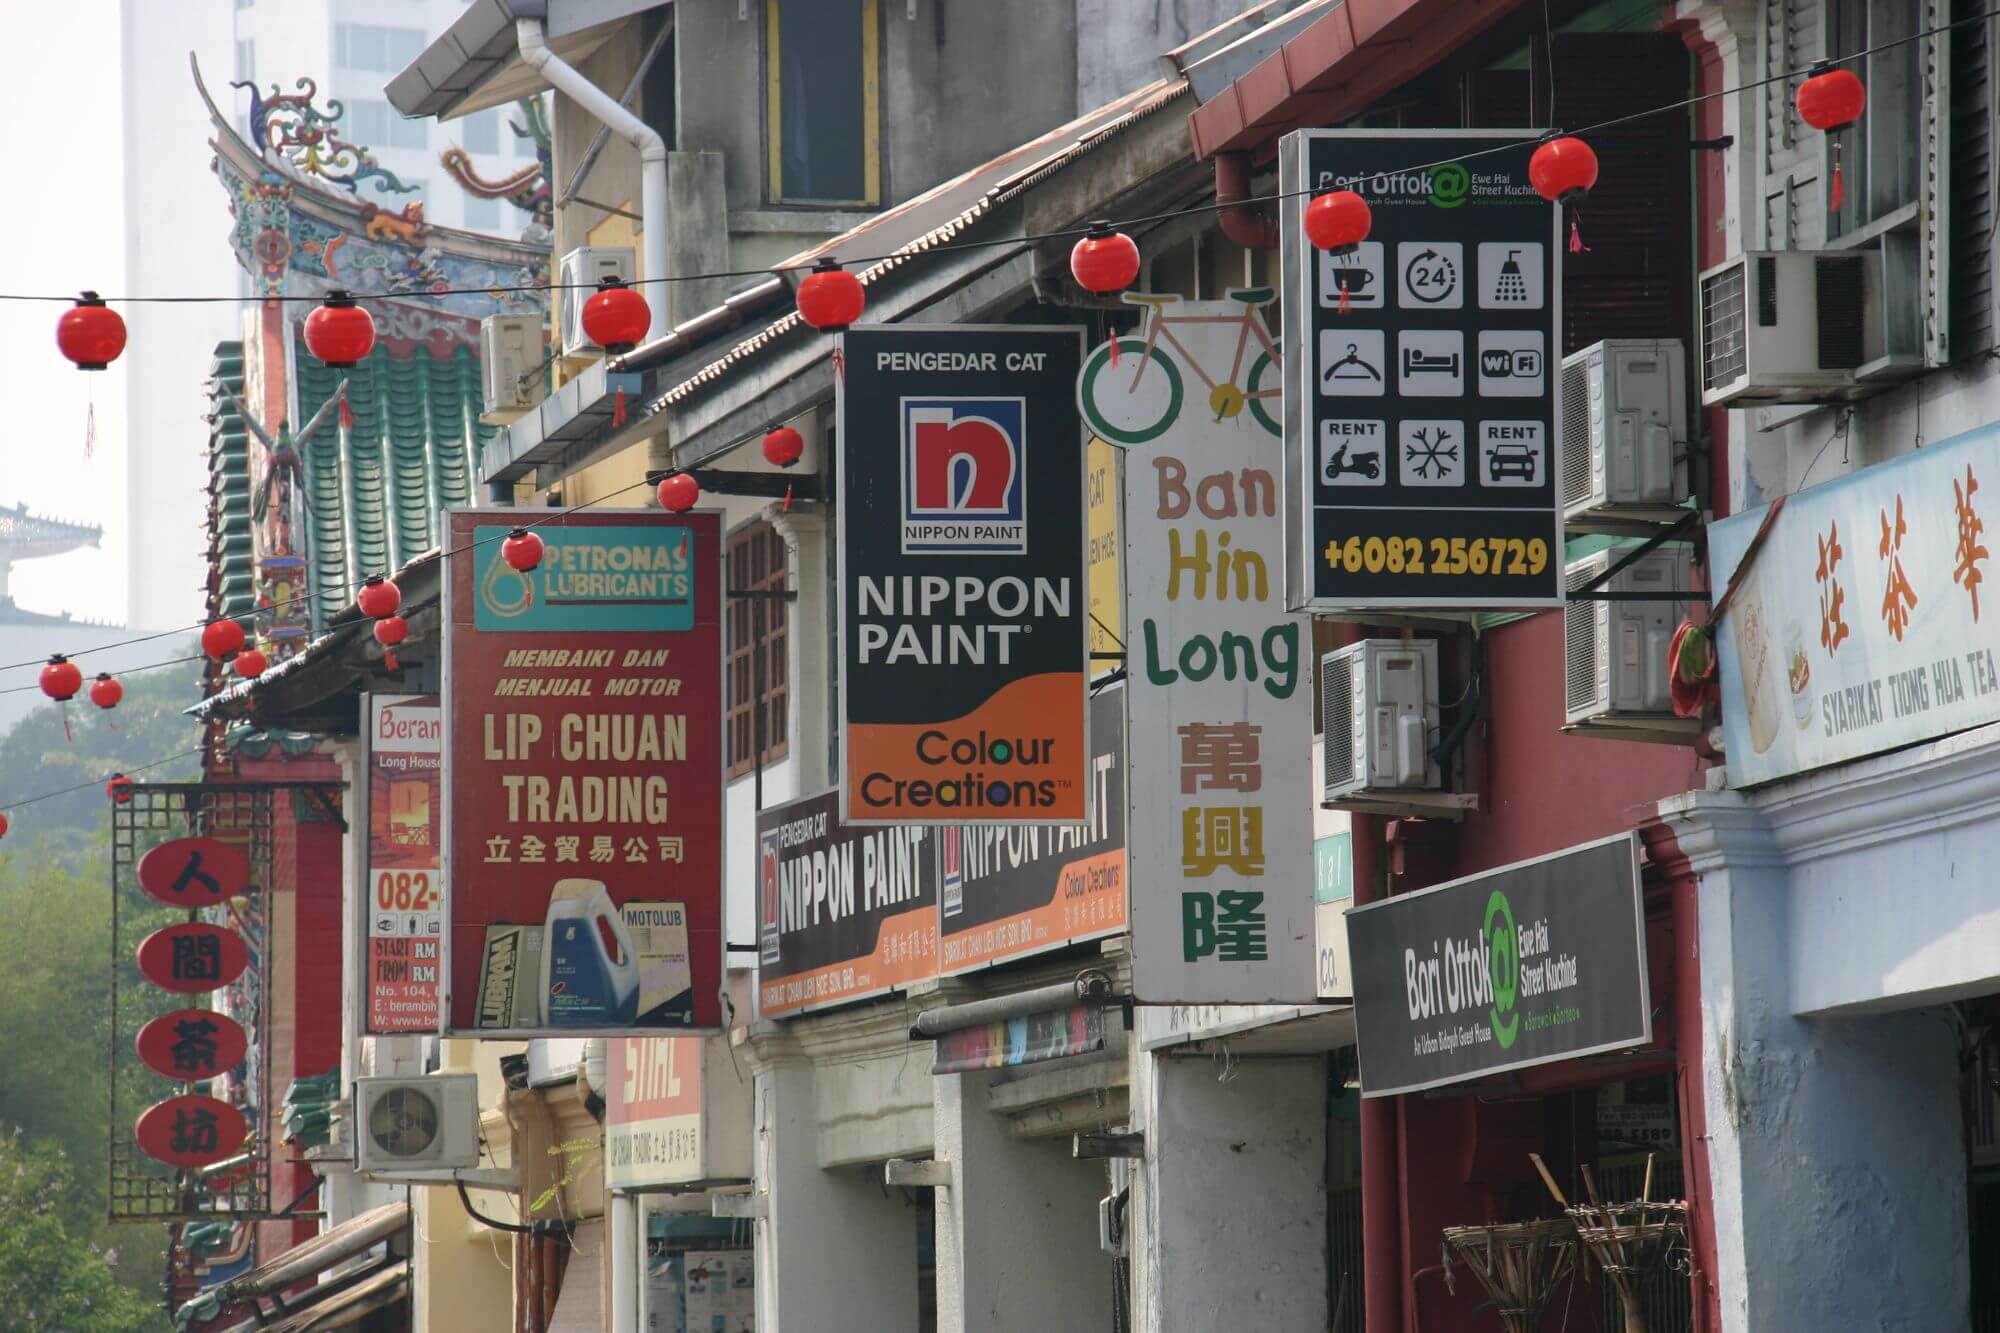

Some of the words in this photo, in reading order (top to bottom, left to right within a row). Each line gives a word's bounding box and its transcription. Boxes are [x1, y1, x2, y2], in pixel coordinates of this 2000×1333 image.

[1372, 170, 1433, 195] Ottok
[1472, 173, 1492, 184] Ewe
[1494, 173, 1510, 184] Hai
[1472, 184, 1502, 196] Street
[1504, 184, 1541, 196] Kuchin
[1415, 267, 1447, 287] 24
[876, 352, 997, 371] PENGEDAR
[1005, 352, 1047, 371] CAT
[1329, 423, 1378, 435] RENT
[1487, 426, 1537, 439] RENT
[1088, 467, 1106, 509] CAT
[1152, 456, 1276, 520] Ban
[905, 526, 969, 540] NIPPON
[974, 526, 1023, 540] PAINT
[544, 545, 688, 572] PETRONAS
[1167, 528, 1269, 602] Hin
[1324, 535, 1425, 574] +6082
[1430, 537, 1548, 576] 256729
[544, 573, 689, 597] LUBRICANTS
[858, 575, 1071, 617] NIPPON
[504, 649, 615, 667] MEMBAIKI
[622, 649, 670, 667] DAN
[1143, 618, 1299, 700] Long
[494, 678, 592, 697] MENJUAL
[604, 678, 682, 697] MOTOR
[1822, 679, 1882, 738] SYARIKAT
[1888, 666, 1930, 719] TIONG
[1931, 657, 1964, 707] HUA
[1967, 647, 1999, 698] TEA
[484, 713, 543, 761] LIP
[560, 713, 687, 762] CHUAN
[916, 730, 1055, 766] Colour
[379, 756, 407, 770] Long
[502, 775, 669, 824] TRADING
[780, 816, 814, 848] PENGEDAR
[814, 812, 828, 839] CAT
[484, 835, 686, 864] 立全貿易公司
[780, 839, 855, 935] NIPPON
[863, 826, 924, 912] PAINT
[627, 909, 682, 927] MOTOLUB
[375, 937, 410, 957] START
[414, 942, 436, 959] RM
[1518, 924, 1534, 958] Ewe
[1535, 918, 1549, 954] Hai
[376, 961, 408, 983] FROM
[412, 966, 435, 982] RM
[1405, 940, 1443, 1021] Bori
[1445, 928, 1494, 1014] Ottok
[1520, 962, 1545, 997] Street
[1546, 954, 1577, 994] Kuching
[375, 986, 398, 996] No.
[623, 1038, 681, 1104] STIHL
